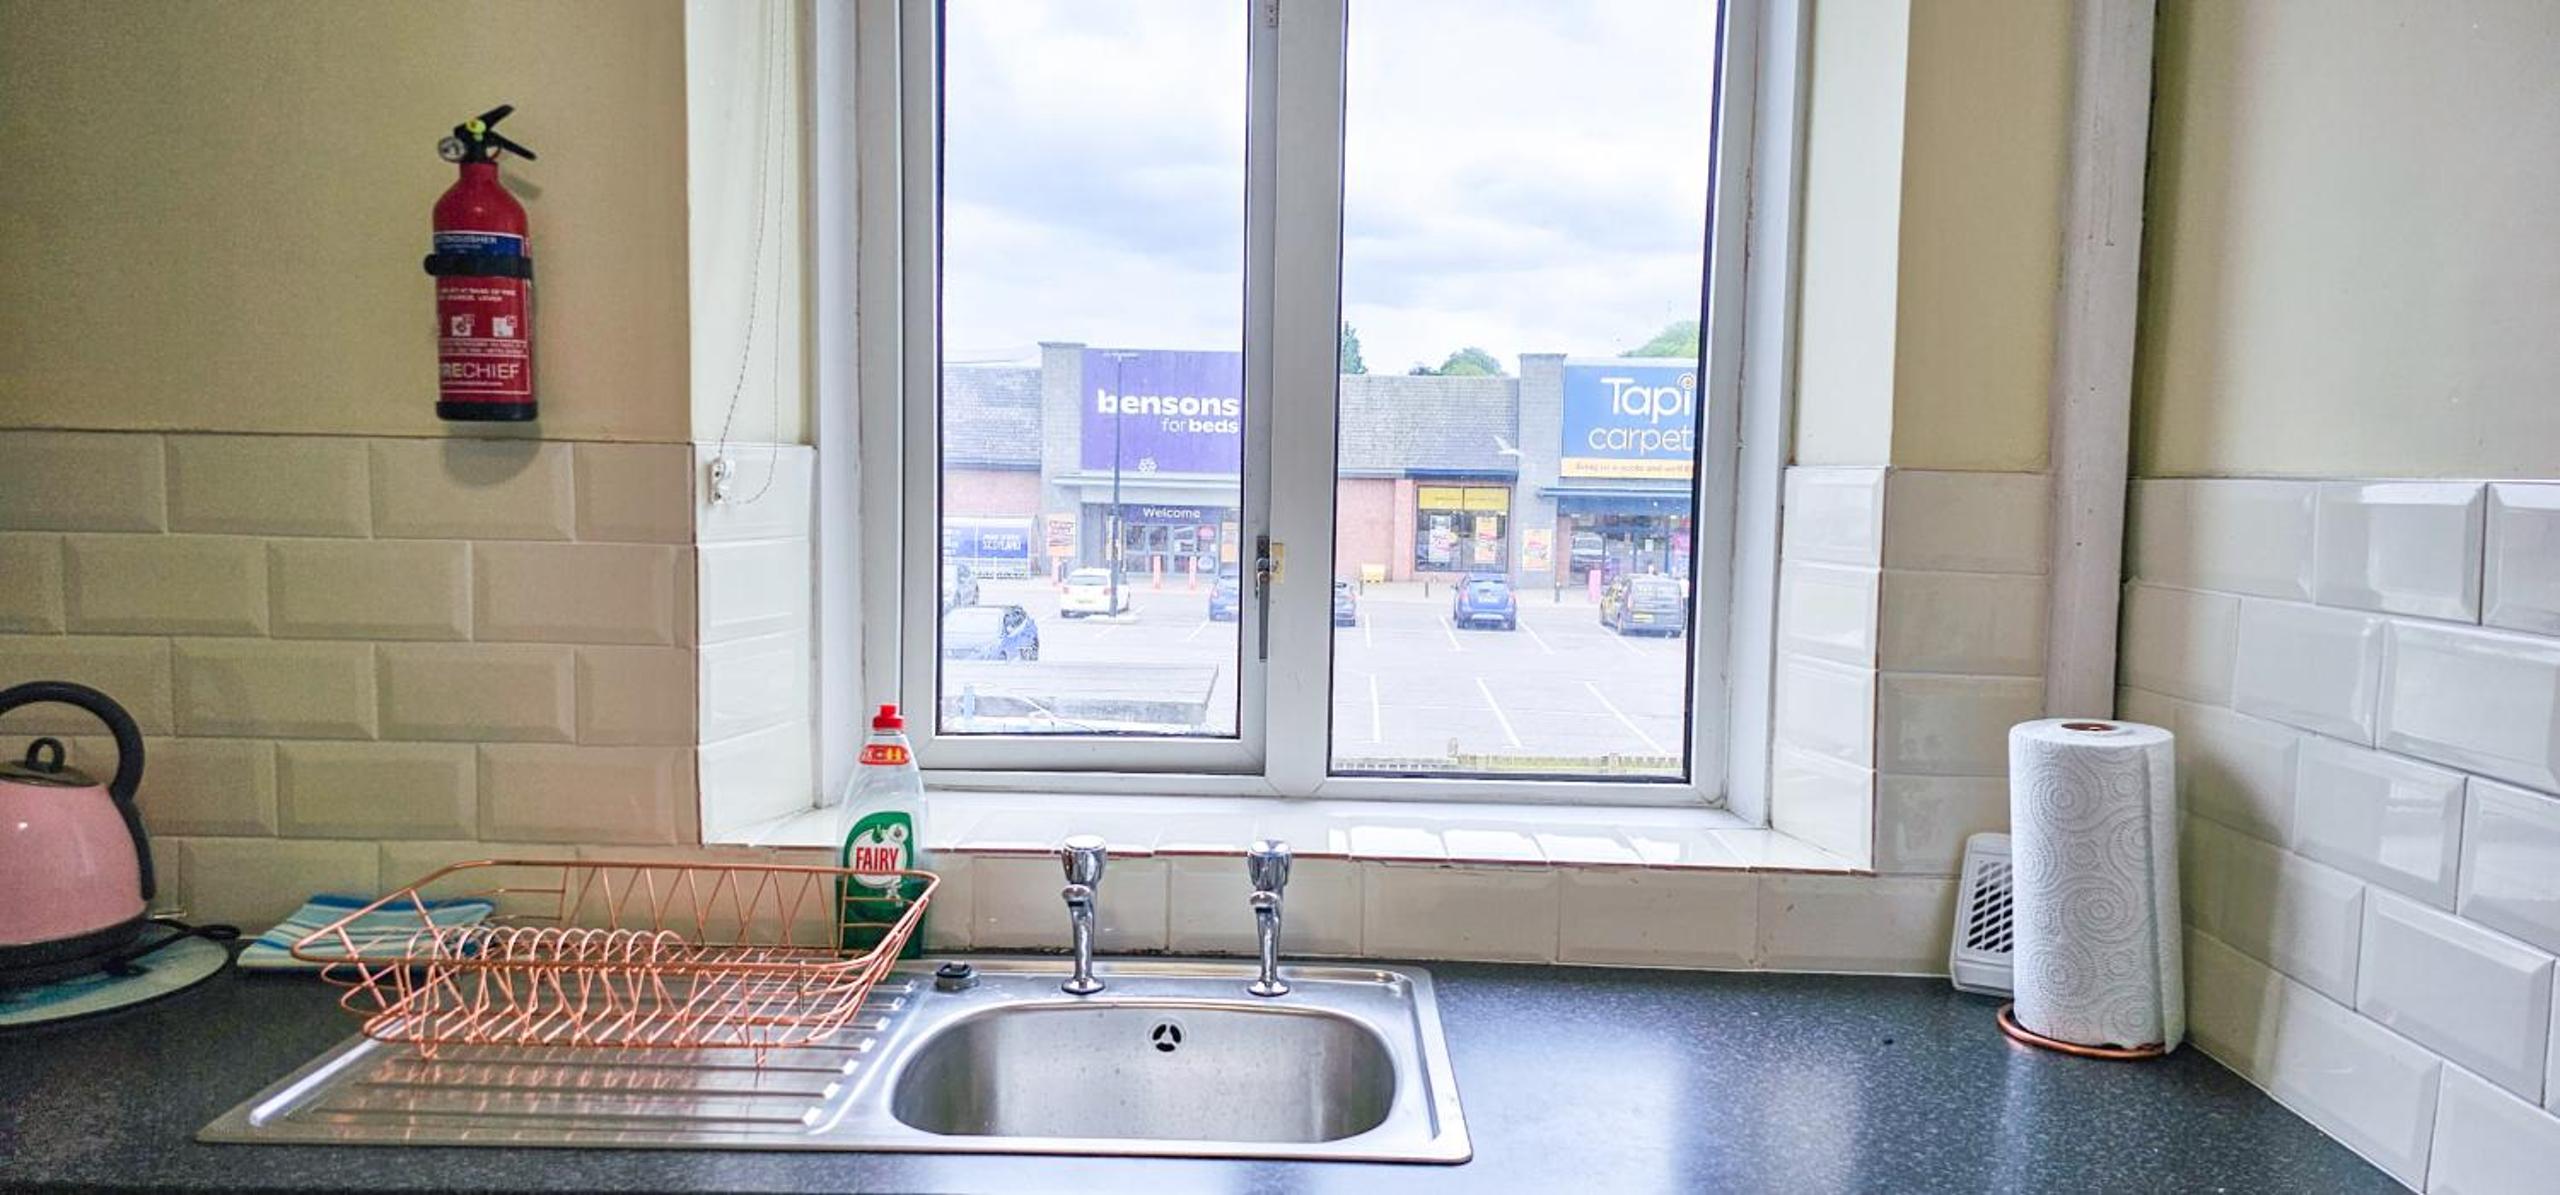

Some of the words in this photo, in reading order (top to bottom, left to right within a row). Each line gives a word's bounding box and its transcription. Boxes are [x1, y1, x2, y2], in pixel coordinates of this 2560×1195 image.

[1097, 388, 1239, 416] bensons
[1600, 372, 1695, 424] Tapi
[1161, 418, 1186, 433] for
[1188, 418, 1239, 434] beds
[1143, 507, 1201, 519] Welcome
[855, 847, 899, 871] FAIRY
